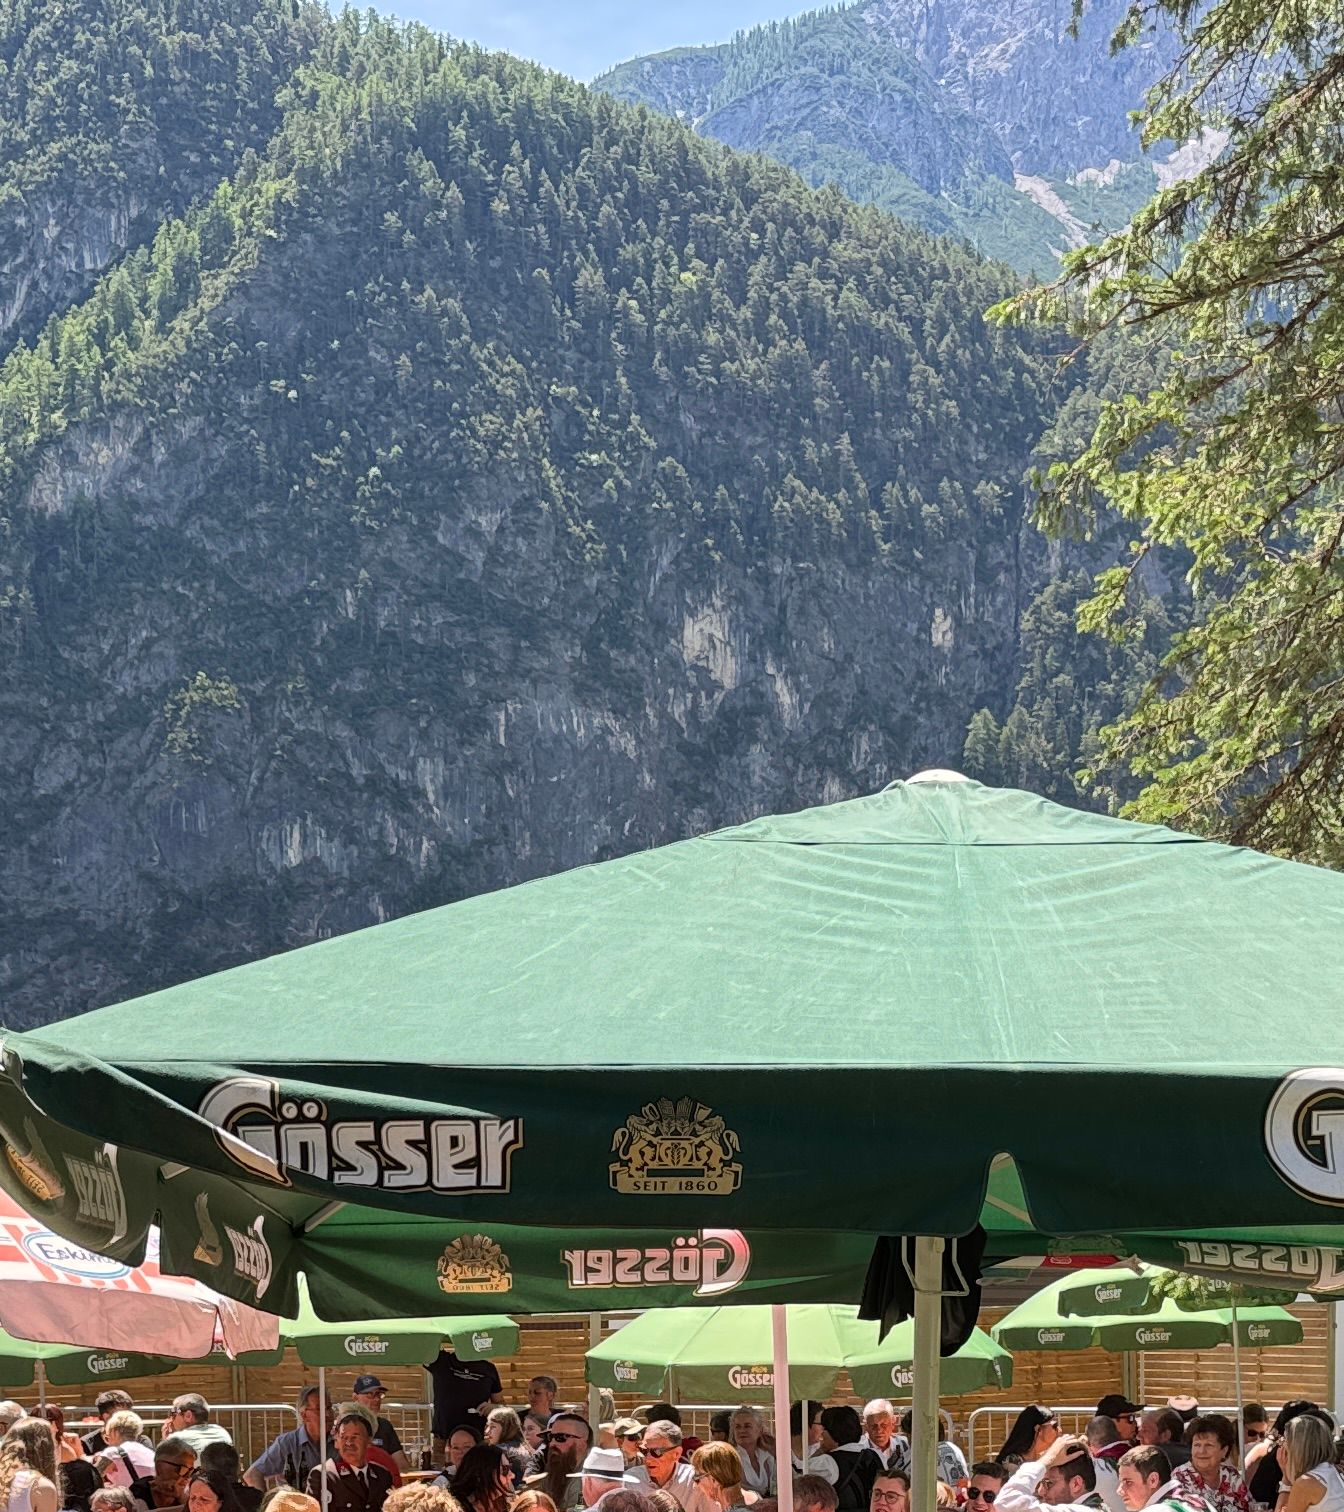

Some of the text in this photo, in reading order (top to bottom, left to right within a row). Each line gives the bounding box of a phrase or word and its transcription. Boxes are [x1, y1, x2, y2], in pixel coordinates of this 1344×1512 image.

[199, 1077, 523, 1195] Gösser
[632, 1180, 718, 1191] SEIT 1860
[1135, 1327, 1172, 1344] Gösser
[344, 1336, 389, 1356] Gösser
[87, 1354, 128, 1374] Gösser
